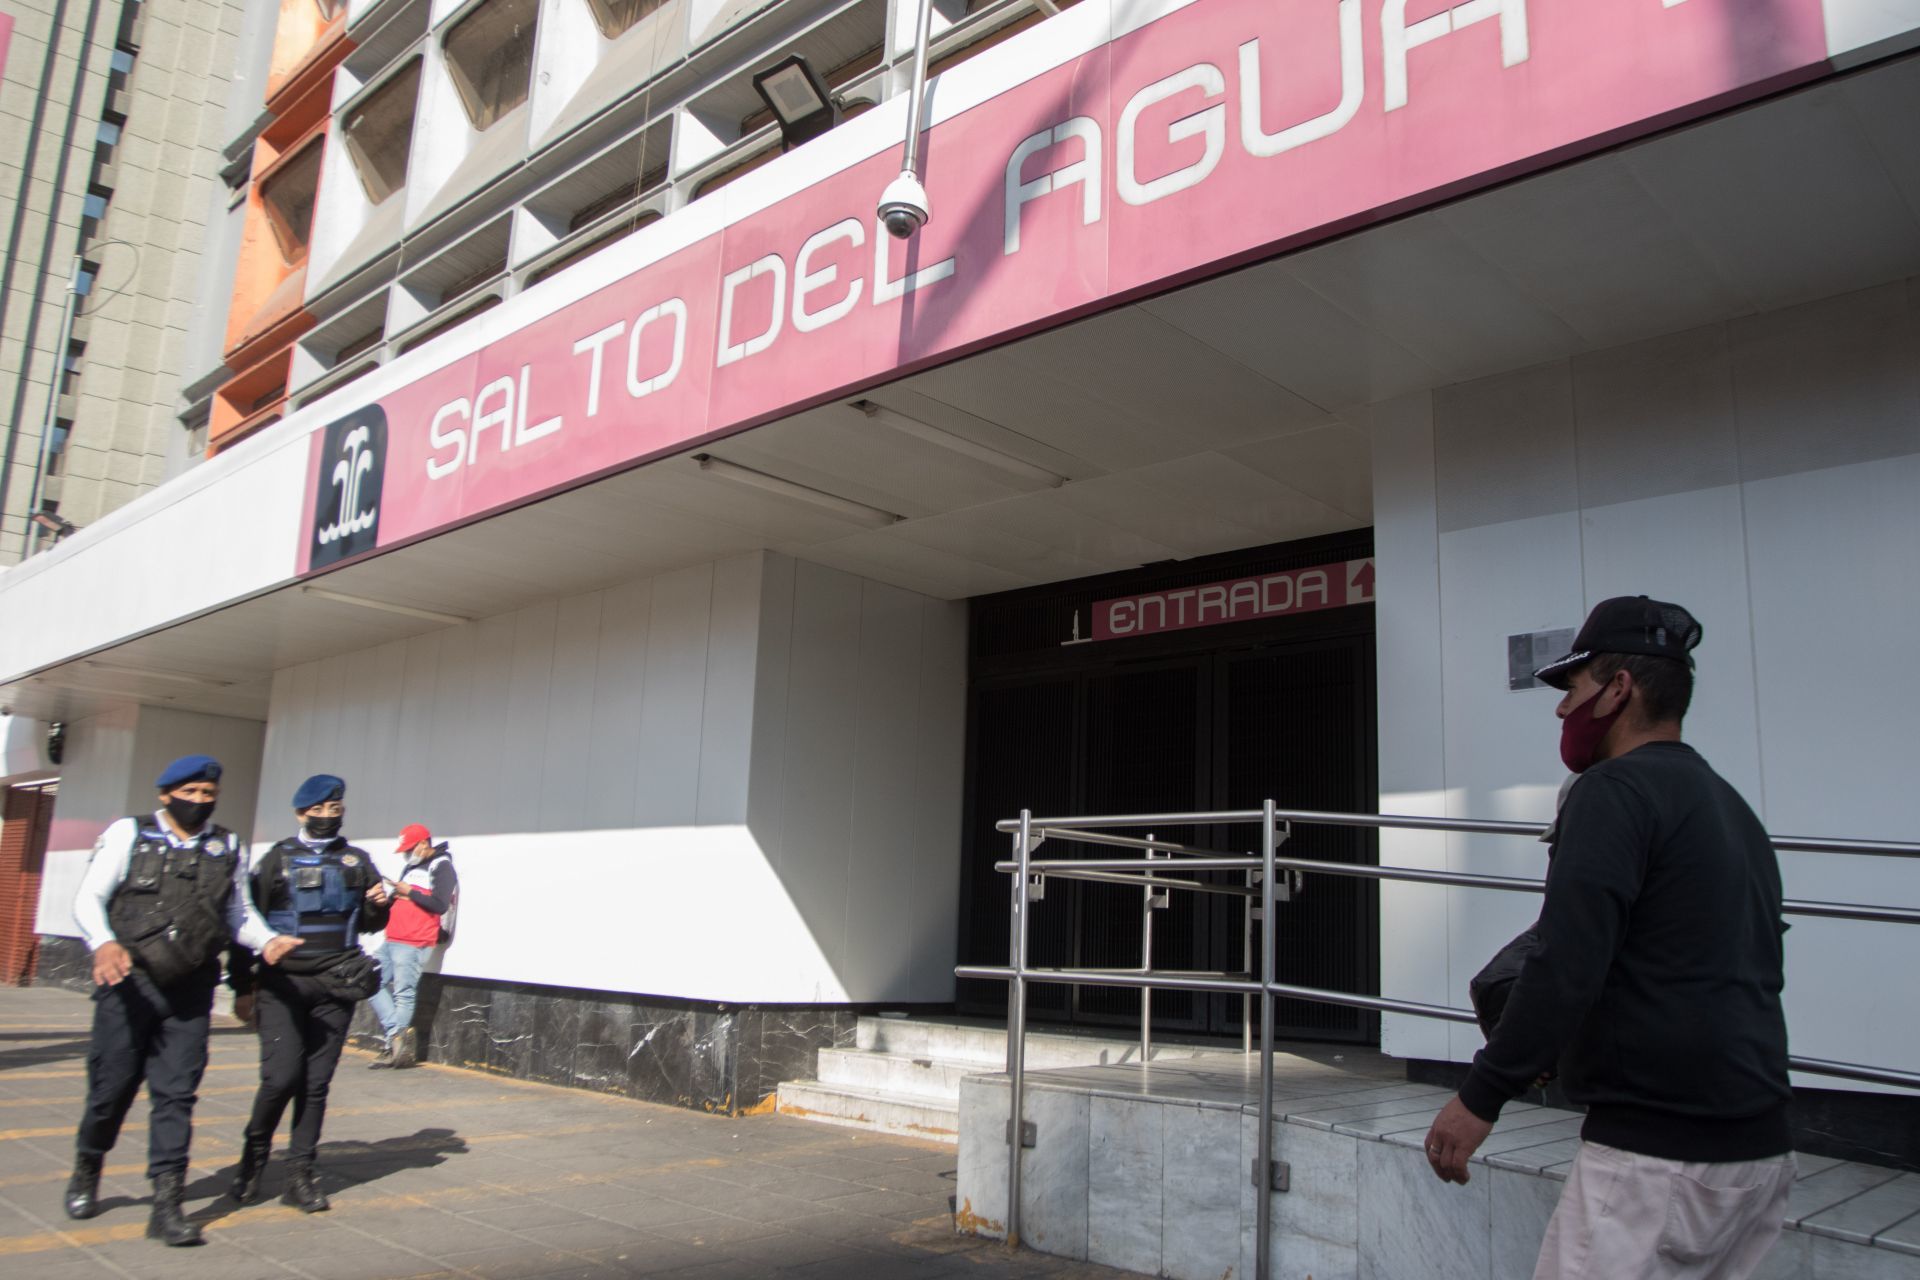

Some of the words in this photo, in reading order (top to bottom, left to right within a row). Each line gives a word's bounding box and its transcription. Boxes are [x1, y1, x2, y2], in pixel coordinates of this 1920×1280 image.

[426, 297, 688, 481] SALTO
[717, 216, 955, 368] DEL
[1004, 0, 1529, 257] AGUA
[1109, 569, 1328, 634] ENTRADA
